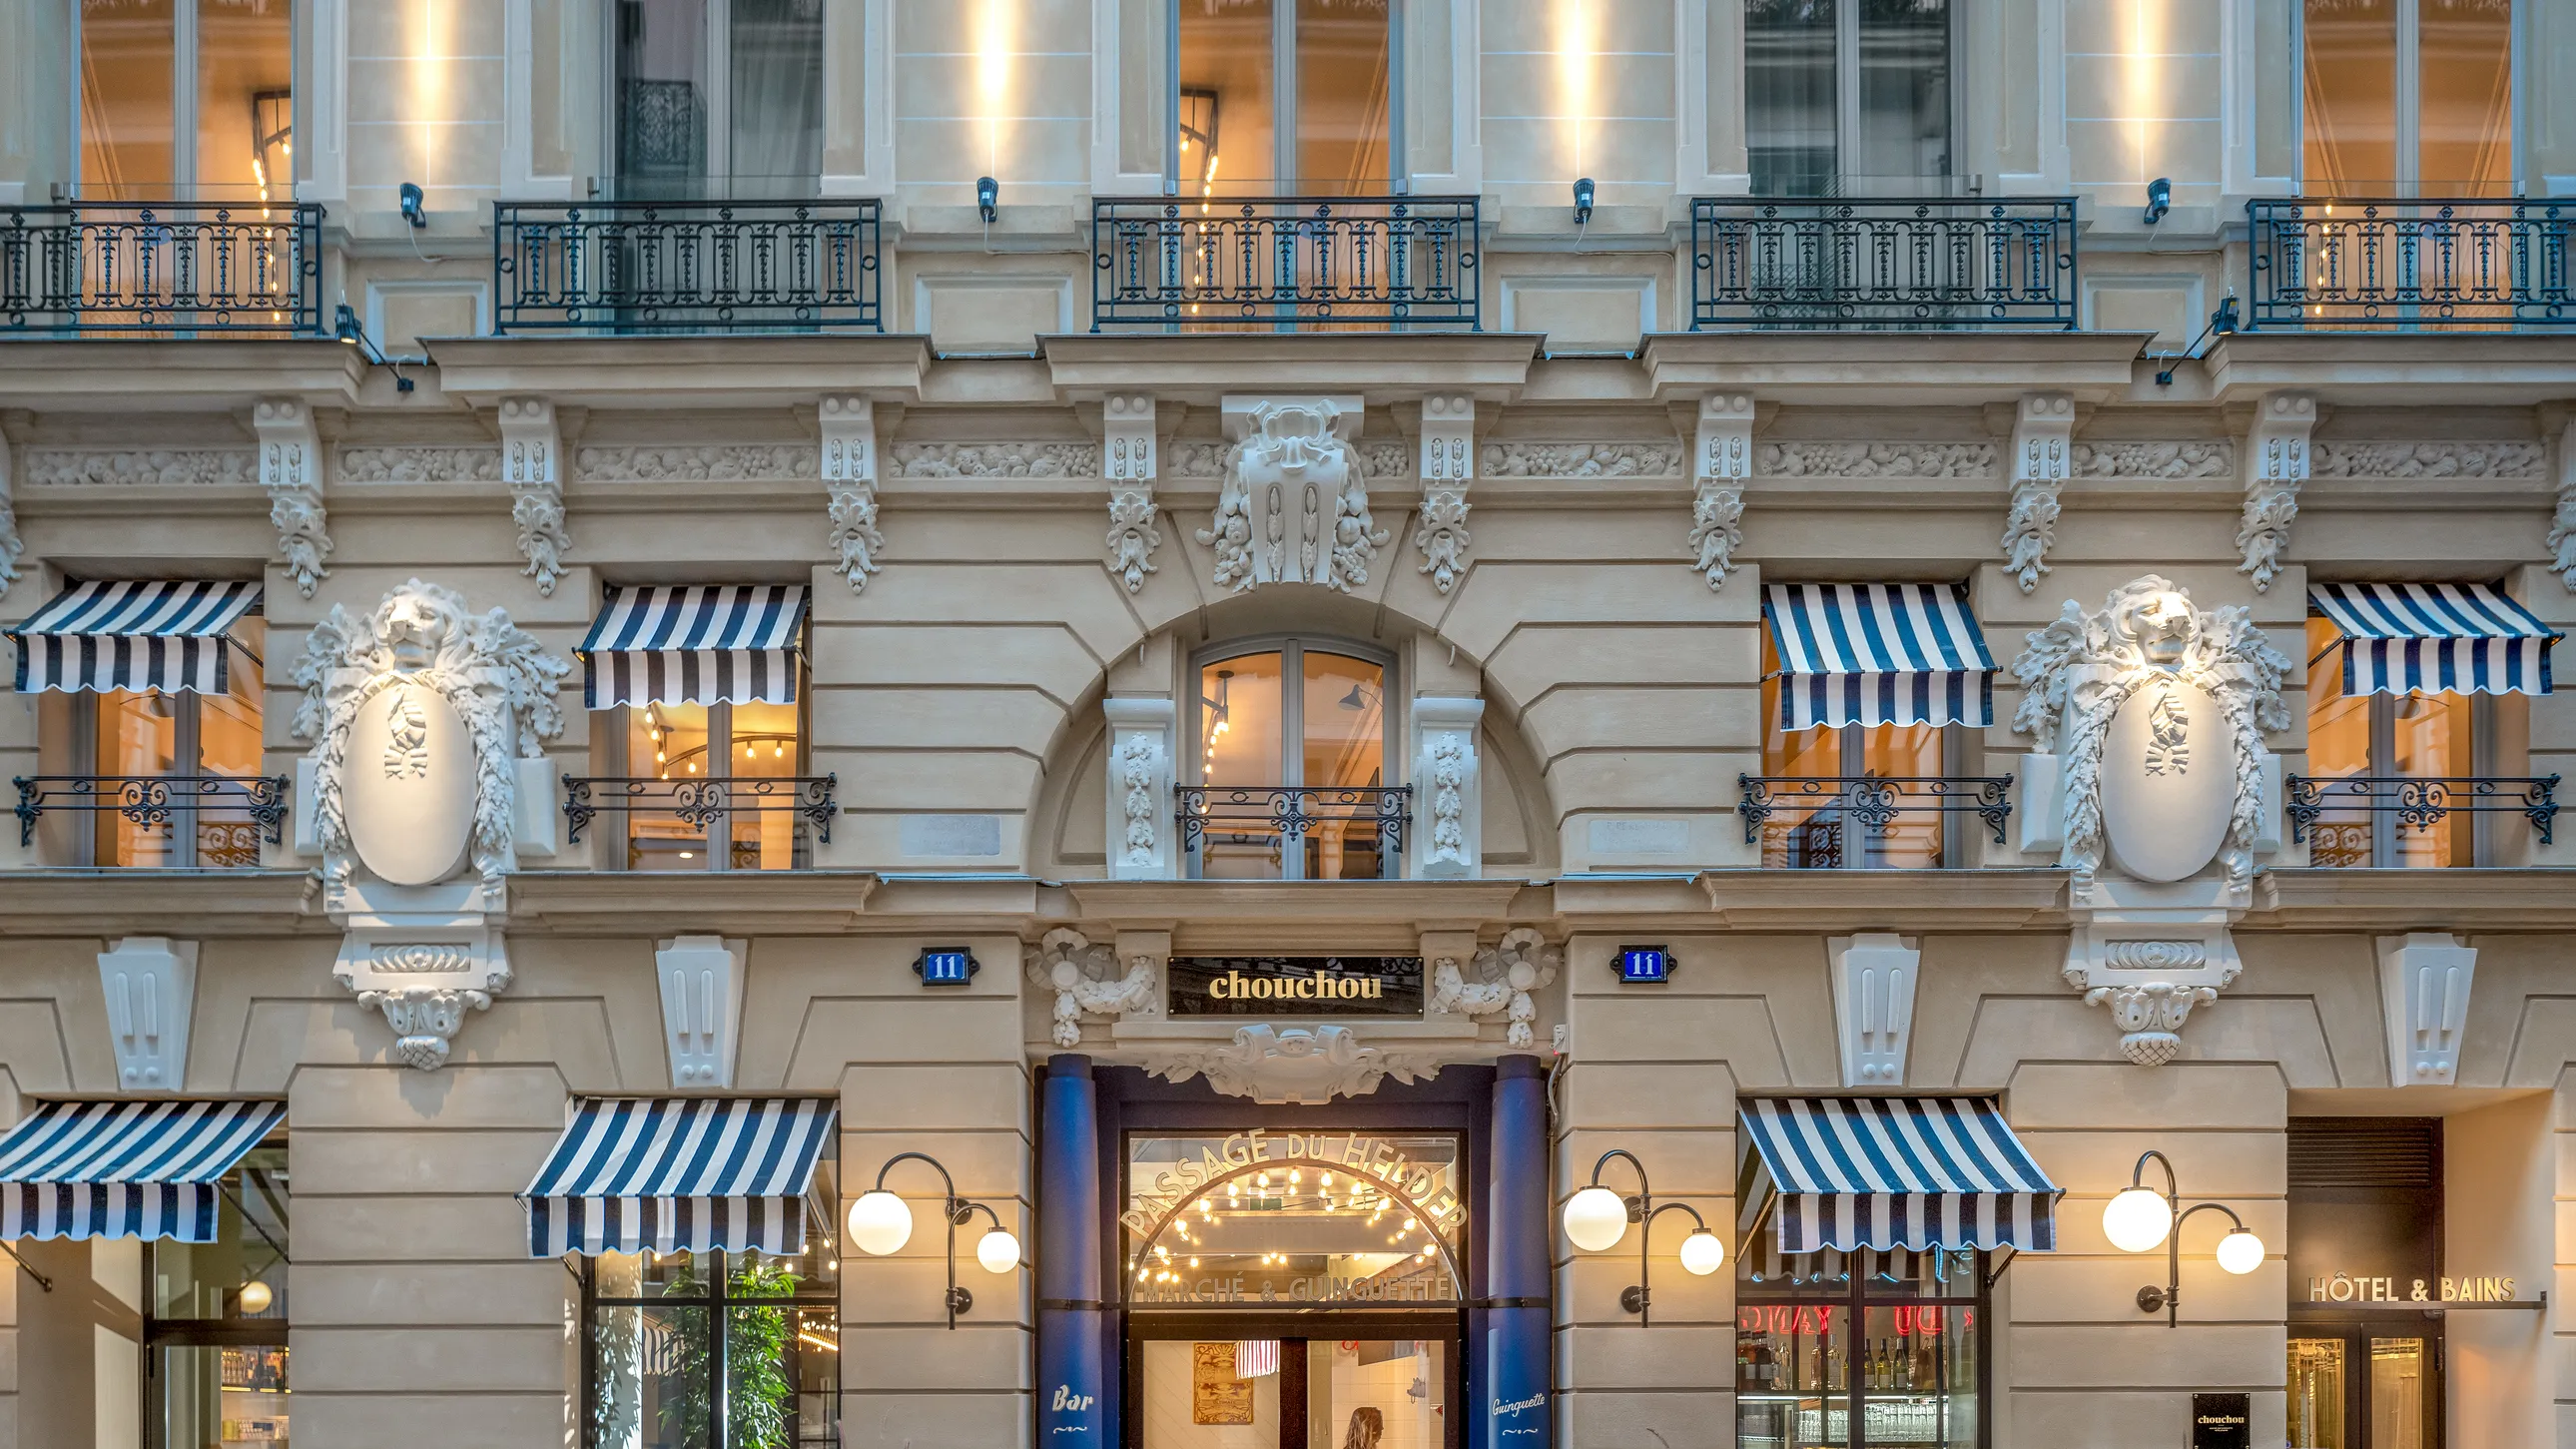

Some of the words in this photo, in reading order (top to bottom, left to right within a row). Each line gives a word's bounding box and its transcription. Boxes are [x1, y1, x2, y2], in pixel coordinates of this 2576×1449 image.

[935, 956, 958, 979] 11
[1632, 953, 1654, 976] 11
[1209, 970, 1383, 999] chouchou
[1119, 1127, 1271, 1239] PASSAGE
[1287, 1133, 1327, 1160] DU
[1340, 1131, 1468, 1238] HELDER
[1144, 1270, 1245, 1302] MARCHÉ
[1260, 1279, 1277, 1302] &
[1288, 1276, 1449, 1302] GUINGUETTE
[2308, 1269, 2399, 1302] HÔTEL
[2410, 1278, 2429, 1302] &
[2440, 1276, 2516, 1302] BAINS
[1051, 1384, 1095, 1412] Bar
[1492, 1392, 1546, 1418] Guinguette
[2198, 1414, 2245, 1424] chouchou
